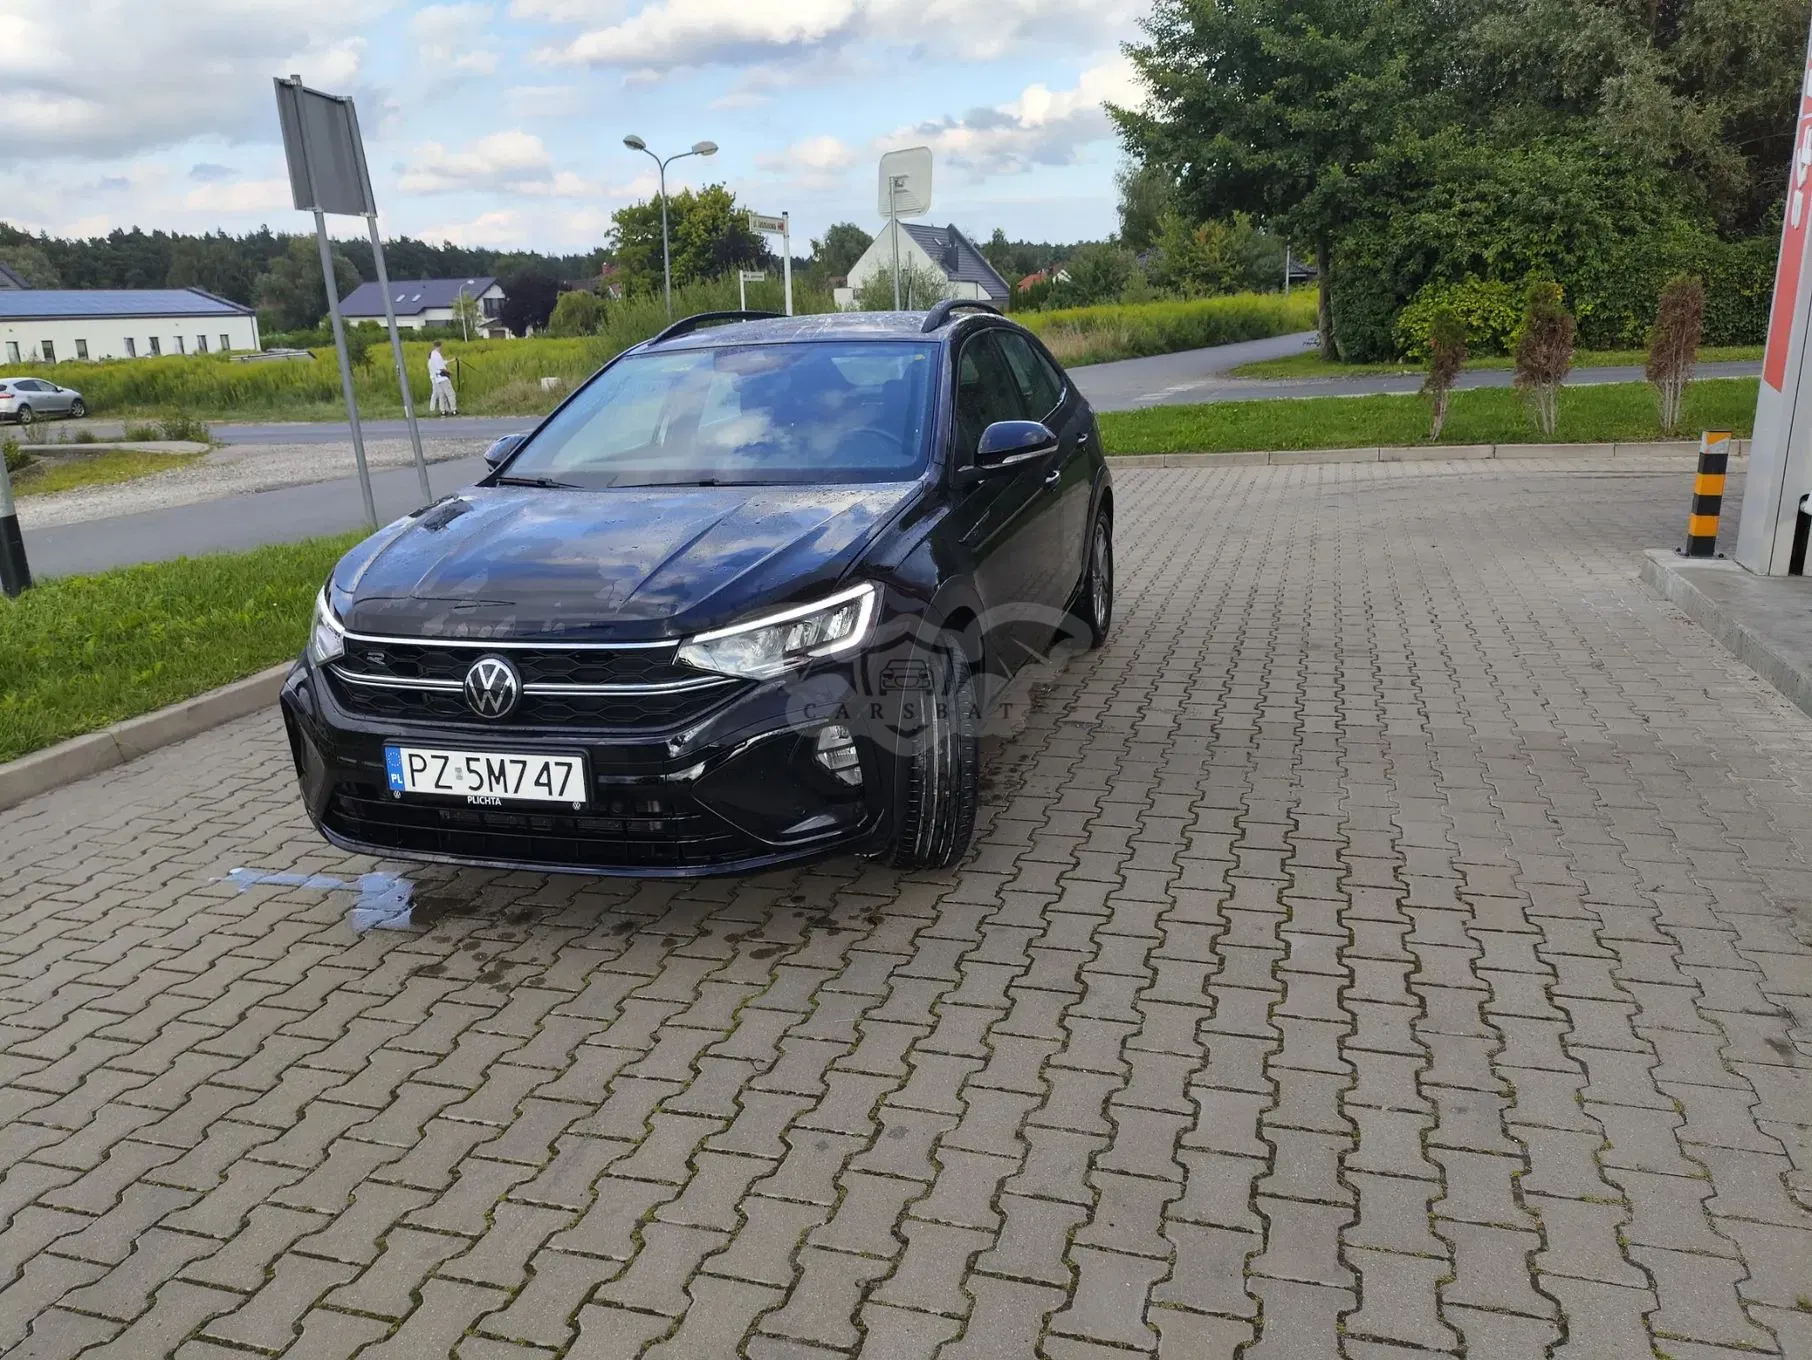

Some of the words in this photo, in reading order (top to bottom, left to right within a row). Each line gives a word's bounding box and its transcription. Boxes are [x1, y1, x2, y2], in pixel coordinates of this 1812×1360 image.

[390, 773, 404, 784] PL
[408, 753, 453, 790] PZ
[465, 756, 573, 797] 5M747
[467, 795, 502, 806] PLICHTA
